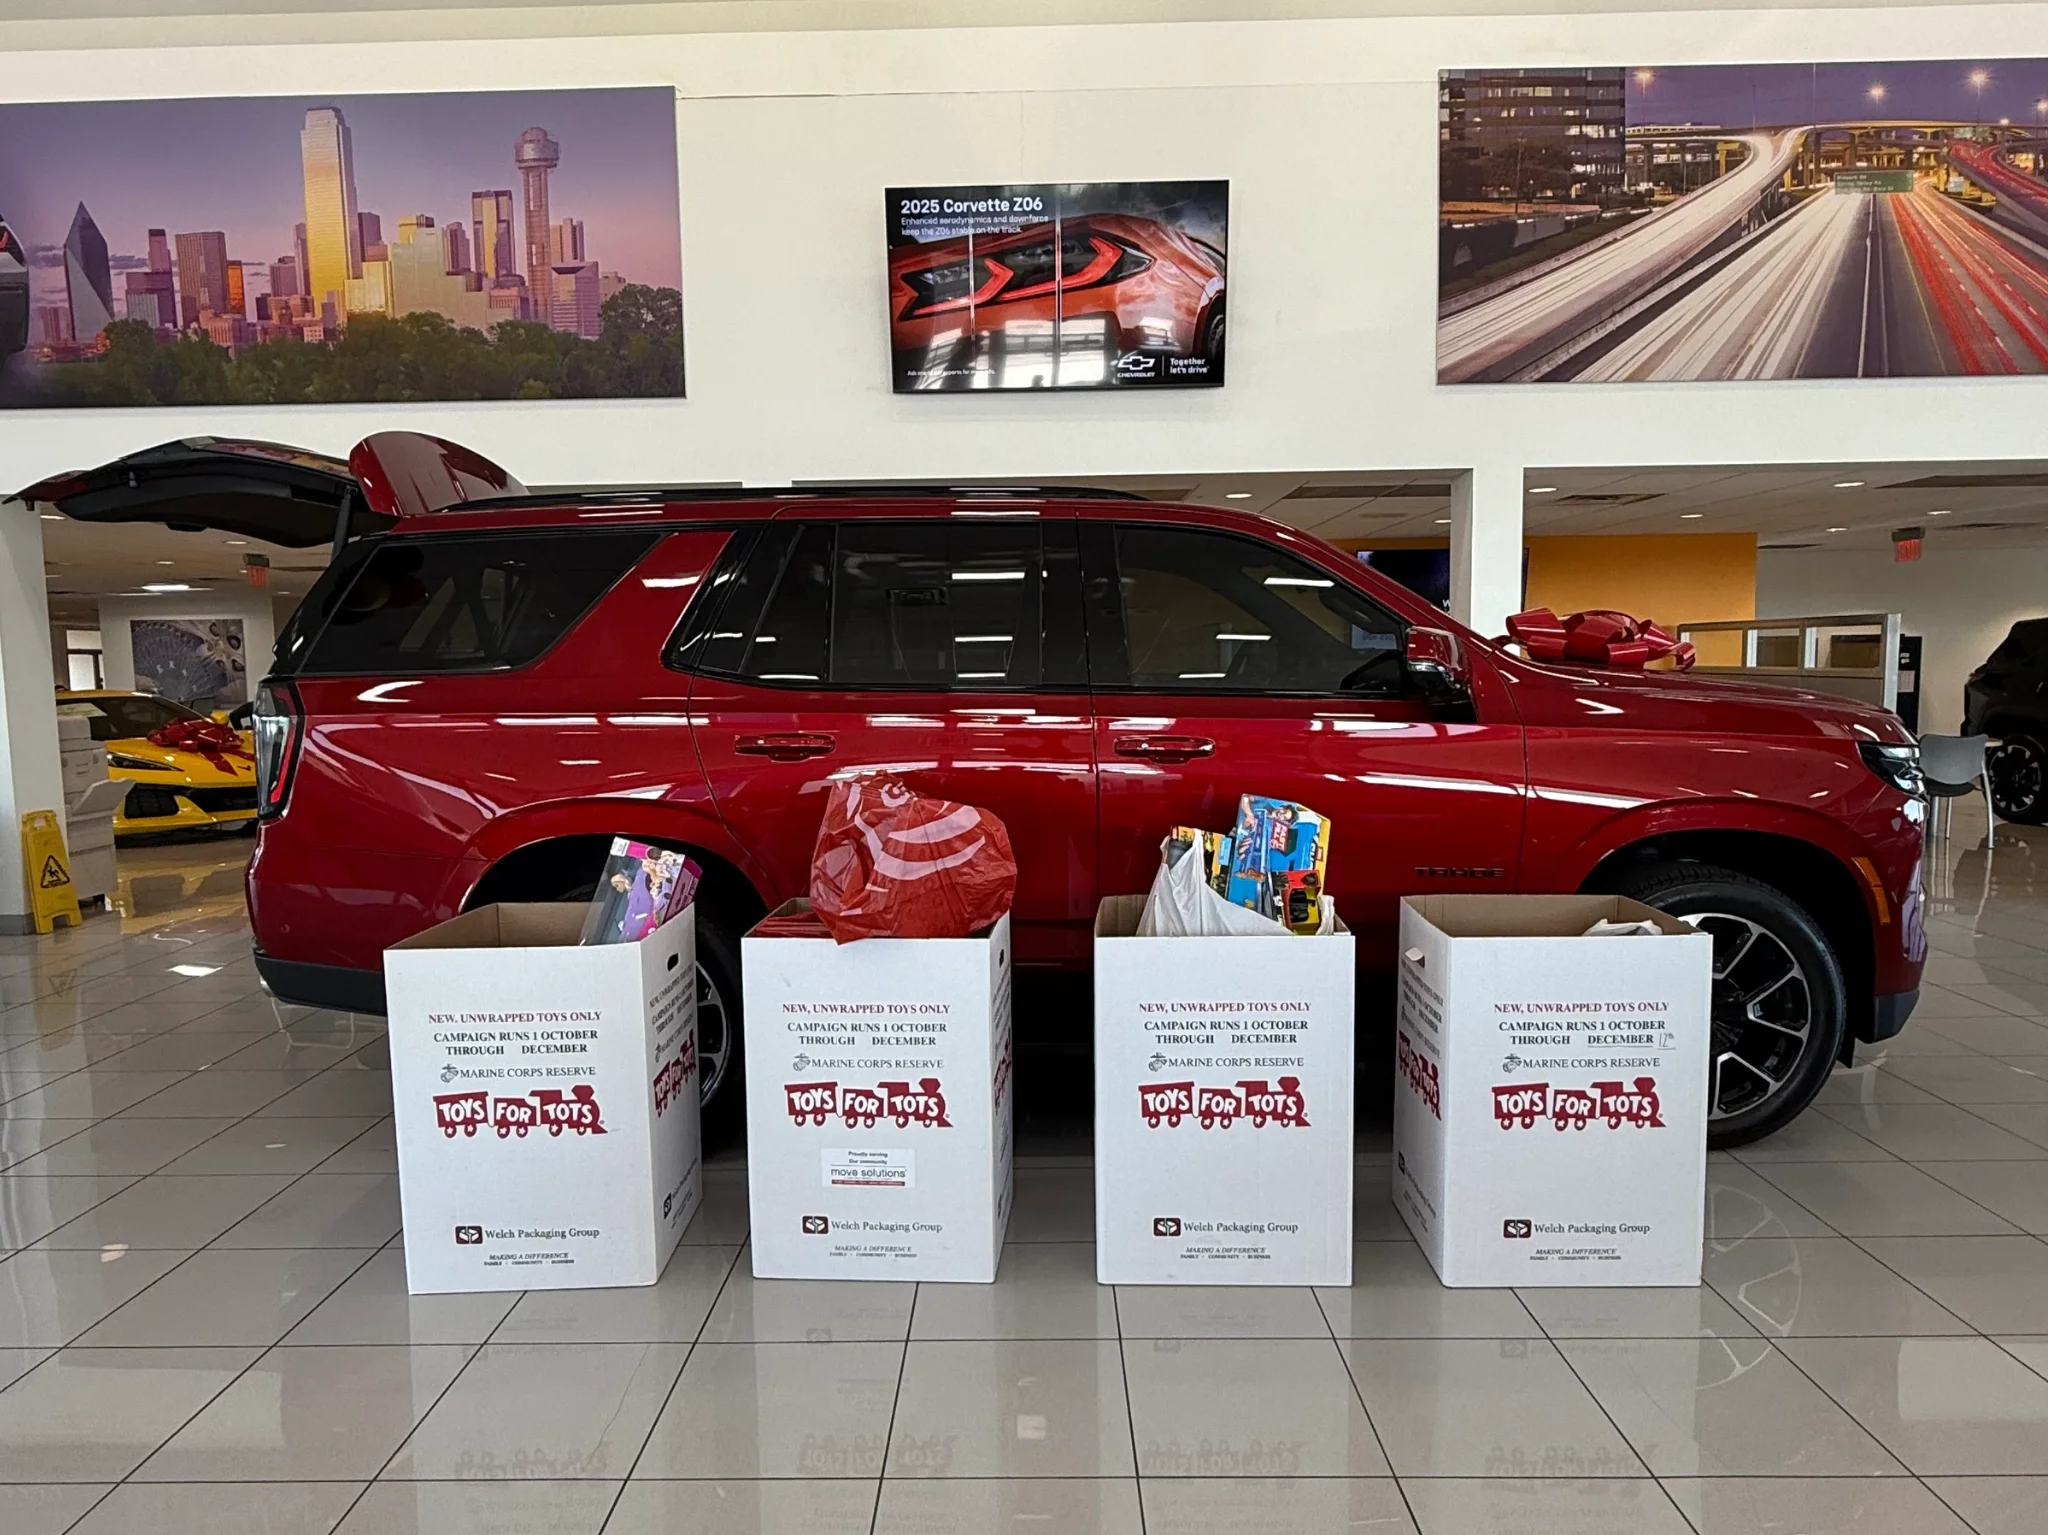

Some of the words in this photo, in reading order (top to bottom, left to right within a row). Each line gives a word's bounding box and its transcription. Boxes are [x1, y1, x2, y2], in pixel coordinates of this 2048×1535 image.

[901, 200, 940, 214] 2025
[943, 199, 1010, 213] Corvette
[1013, 197, 1043, 211] Z06
[901, 217, 938, 225] Enhanced
[940, 215, 992, 225] aerodynamics
[993, 215, 1007, 223] and
[1009, 214, 1049, 223] downforce
[901, 227, 919, 236] keep
[921, 227, 934, 235] the
[935, 226, 950, 235] Z06
[987, 225, 999, 233] the
[1170, 357, 1206, 367] Together
[782, 1004, 810, 1014] NEW,
[813, 1004, 884, 1014] UNWRAPPED
[887, 1004, 916, 1014] TOYS
[919, 1004, 950, 1014] ONLY
[1139, 1003, 1168, 1014] NEW,
[1171, 1003, 1244, 1012] UNWRAPPED
[1247, 1003, 1278, 1012] TOYS
[1280, 1002, 1312, 1012] ONLY
[1494, 1004, 1524, 1014] NEW,
[1527, 1003, 1601, 1013] UNWRAPPED
[1604, 1002, 1635, 1012] TOYS
[1638, 1002, 1669, 1012] ONLY
[461, 1012, 534, 1023] UNWRAPPED
[537, 1012, 567, 1022] TOYS
[570, 1011, 602, 1021] ONLY
[788, 1022, 847, 1032] CAMPAIGN
[851, 1023, 882, 1032] RUNS
[884, 1023, 888, 1032] 1
[891, 1023, 946, 1032] OCTOBER
[1144, 1021, 1207, 1030] CAMPAIGN
[1210, 1021, 1240, 1030] RUNS
[1244, 1021, 1248, 1030] 1
[1251, 1021, 1308, 1030] OCTOBER
[1499, 1021, 1563, 1031] CAMPAIGN
[1566, 1021, 1597, 1031] RUNS
[1600, 1021, 1605, 1030] 1
[1608, 1020, 1665, 1030] OCTOBER
[434, 1032, 496, 1042] CAMPAIGN
[499, 1031, 529, 1041] RUNS
[532, 1031, 538, 1040] 1
[541, 1030, 598, 1040] OCTOBER
[799, 1036, 855, 1045] THROUGH
[872, 1036, 936, 1046] DECEMBER
[1156, 1035, 1214, 1044] THROUGH
[1231, 1034, 1297, 1043] DECEMBER
[1510, 1036, 1570, 1045] THROUGH
[1588, 1035, 1654, 1044] DECEMBER
[446, 1046, 504, 1055] THROUGH
[521, 1044, 587, 1054] DECEMBER
[812, 1059, 854, 1068] MARINE
[858, 1059, 892, 1068] CORPS
[895, 1060, 944, 1068] RESERVE
[1169, 1058, 1213, 1067] MARINE
[1216, 1058, 1251, 1067] CORPS
[1254, 1058, 1304, 1066] RESERVE
[1523, 1059, 1568, 1068] MARINE
[1571, 1058, 1607, 1068] CORPS
[1610, 1058, 1660, 1067] RESERVE
[460, 1069, 505, 1078] MARINE
[507, 1068, 543, 1077] CORPS
[546, 1066, 596, 1076] RESERVE
[790, 1088, 834, 1112] TOYS
[844, 1096, 880, 1114] FOR
[891, 1096, 938, 1117] TOTS
[1144, 1088, 1190, 1112] TOYS
[1200, 1093, 1236, 1115] FOR
[1248, 1094, 1297, 1116] TOTS
[1497, 1090, 1544, 1113] TOYS
[1555, 1094, 1591, 1116] FOR
[1604, 1095, 1653, 1117] TOTS
[439, 1099, 485, 1122] TOYS
[496, 1102, 532, 1123] FOR
[543, 1102, 593, 1124] TOTS
[831, 1168, 858, 1176] move
[861, 1168, 906, 1178] solutions
[831, 1221, 860, 1231] Welch
[863, 1221, 910, 1232] Packaging
[913, 1222, 942, 1232] Group
[1184, 1222, 1213, 1232] Welch
[1216, 1222, 1265, 1233] Packaging
[1268, 1223, 1298, 1232] Group
[1534, 1224, 1565, 1234] Welch
[1568, 1224, 1616, 1235] Packaging
[1619, 1224, 1650, 1233] Group
[485, 1228, 515, 1239] Welch
[518, 1227, 566, 1239] Packaging
[569, 1227, 599, 1238] Group
